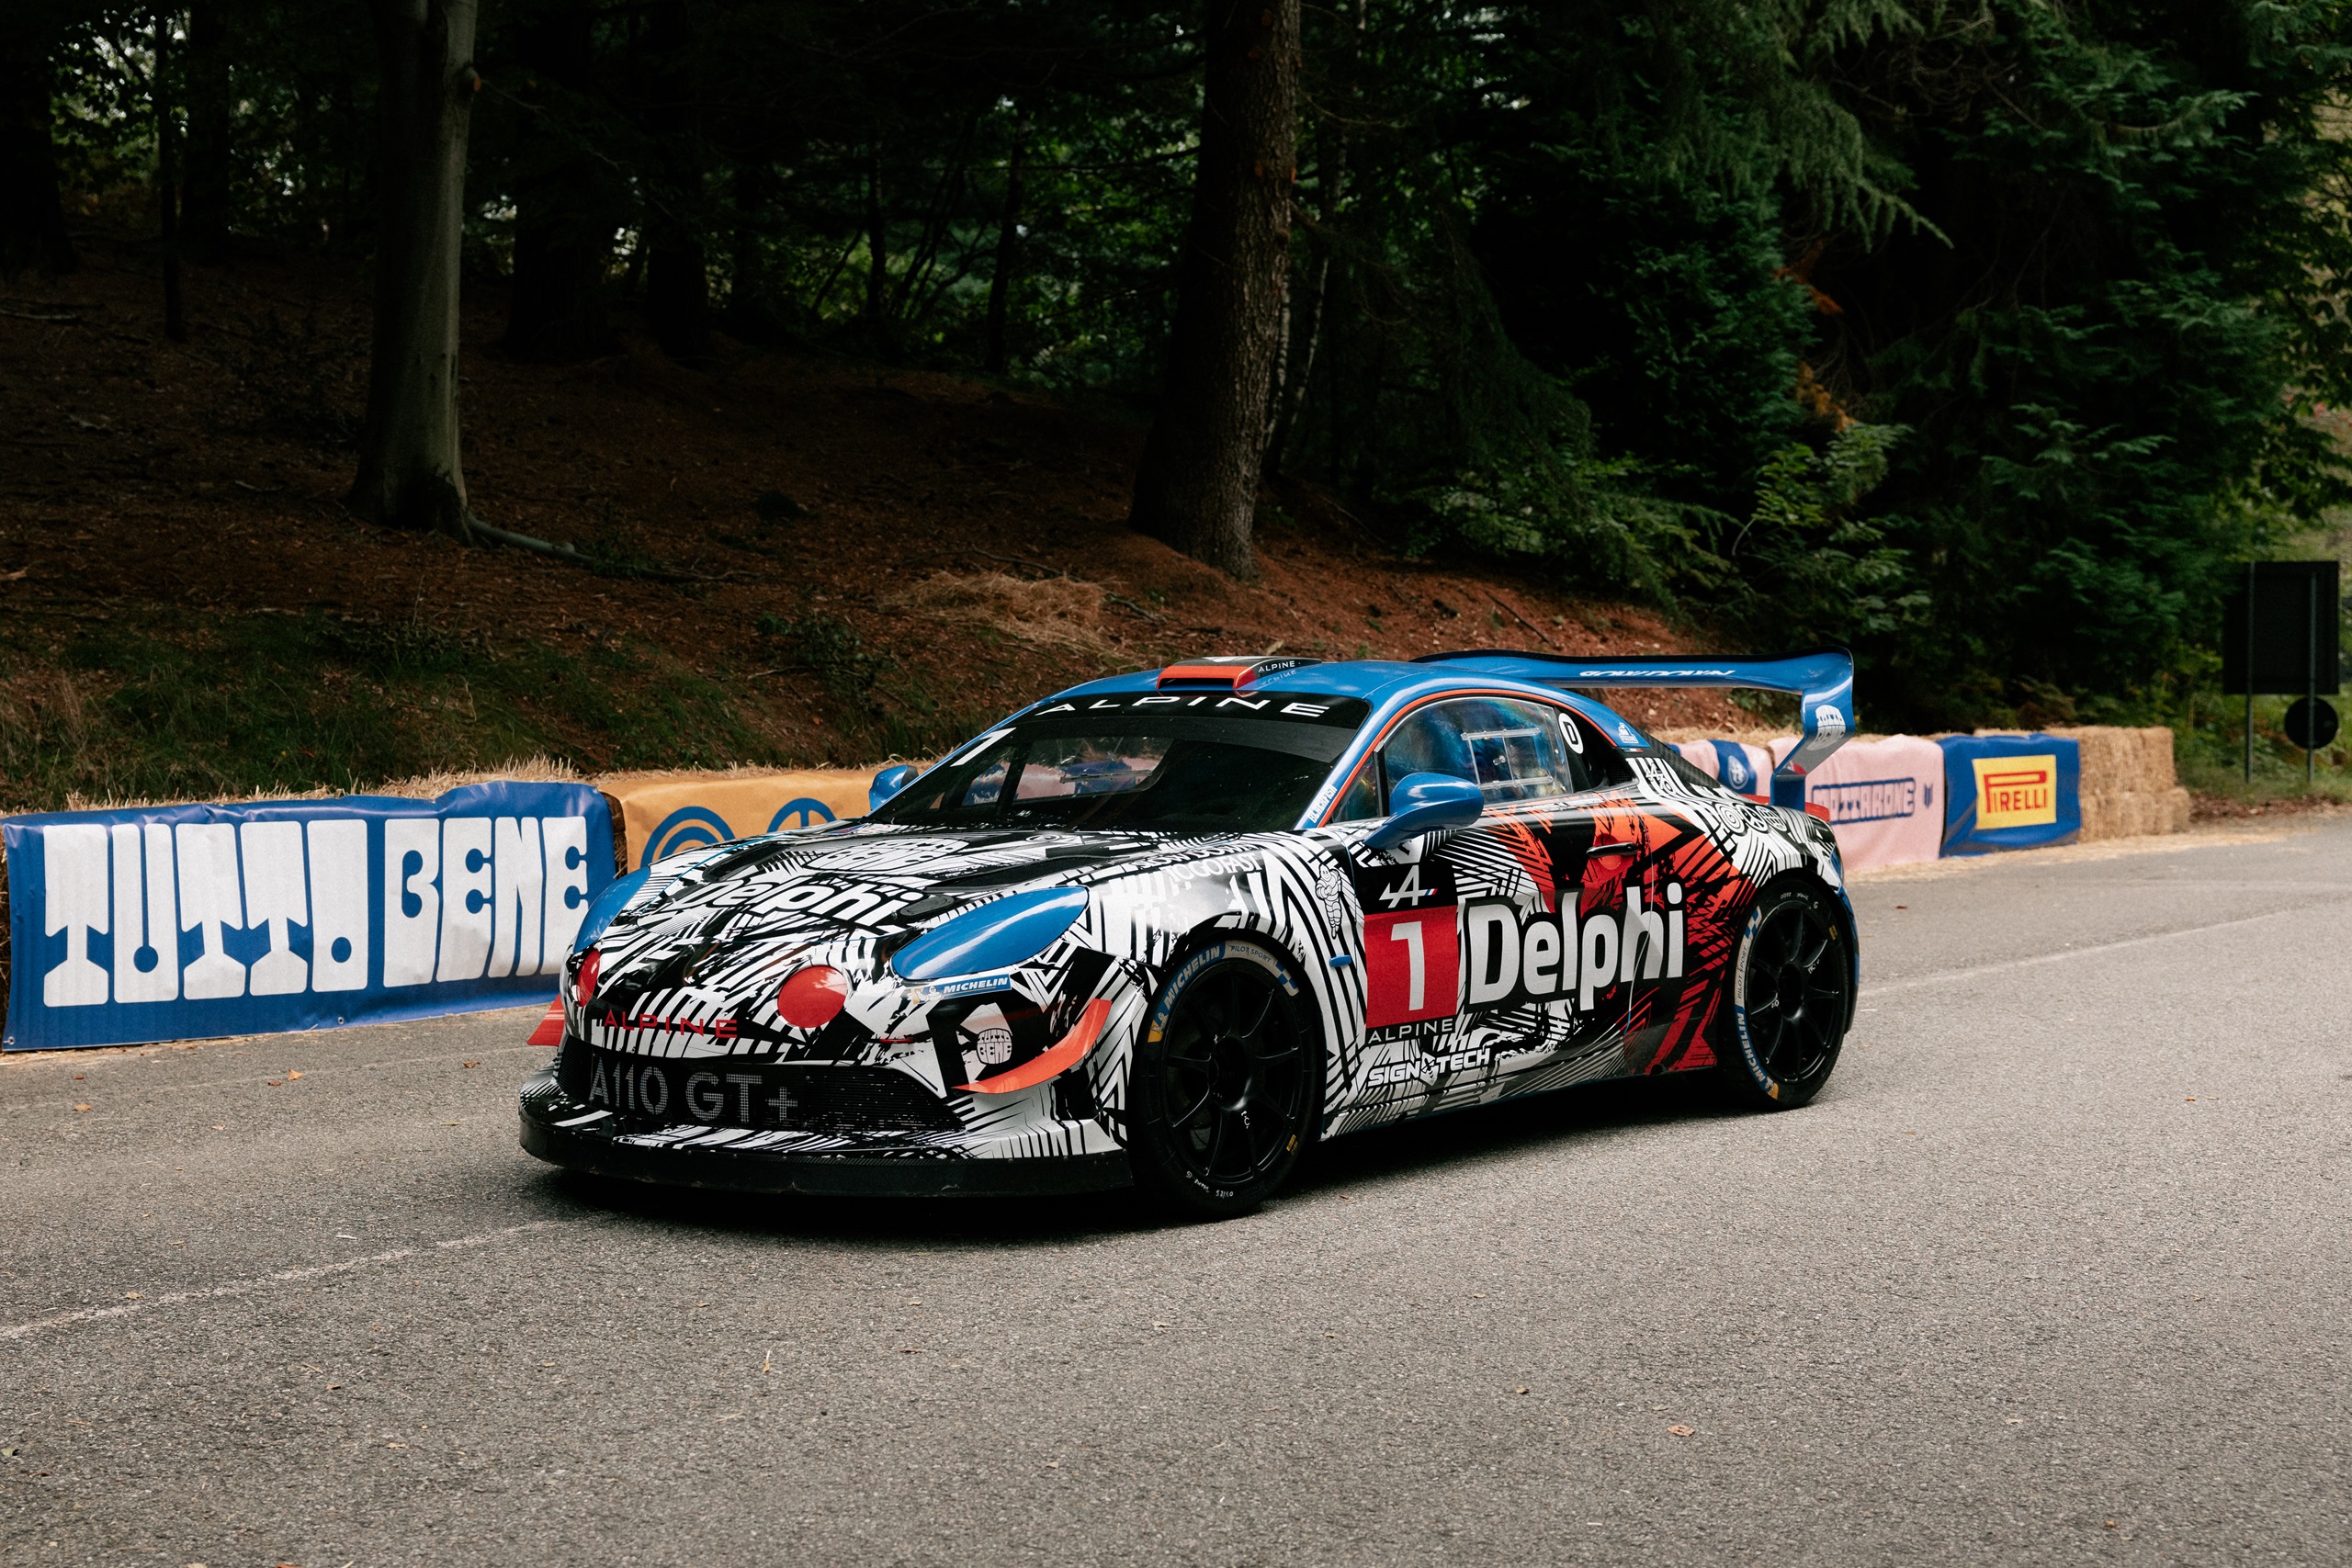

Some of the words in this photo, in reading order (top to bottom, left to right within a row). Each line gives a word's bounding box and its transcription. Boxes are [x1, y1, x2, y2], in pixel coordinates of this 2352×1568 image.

[1258, 660, 1295, 672] ALPINE
[1035, 696, 1329, 717] ALPINE
[1563, 721, 1578, 745] D
[1984, 770, 2047, 814] PIRELLI
[1221, 852, 1263, 874] FAST
[43, 819, 368, 1007] TUTTO
[383, 816, 589, 987] BENE
[669, 875, 924, 926] Delphi
[1391, 920, 1426, 1011] 1
[1469, 882, 1683, 1011] Delphi
[944, 977, 1008, 994] MICHELIN
[1163, 945, 1220, 1009] MICHELIN
[1229, 944, 1250, 955] PILOT
[1250, 948, 1272, 964] SPORT
[605, 1010, 738, 1039] ALPINE
[1368, 1018, 1453, 1044] ALPINE
[1736, 1012, 1766, 1082] MICHELIN
[588, 1056, 669, 1115] A110
[686, 1071, 798, 1123] GT+
